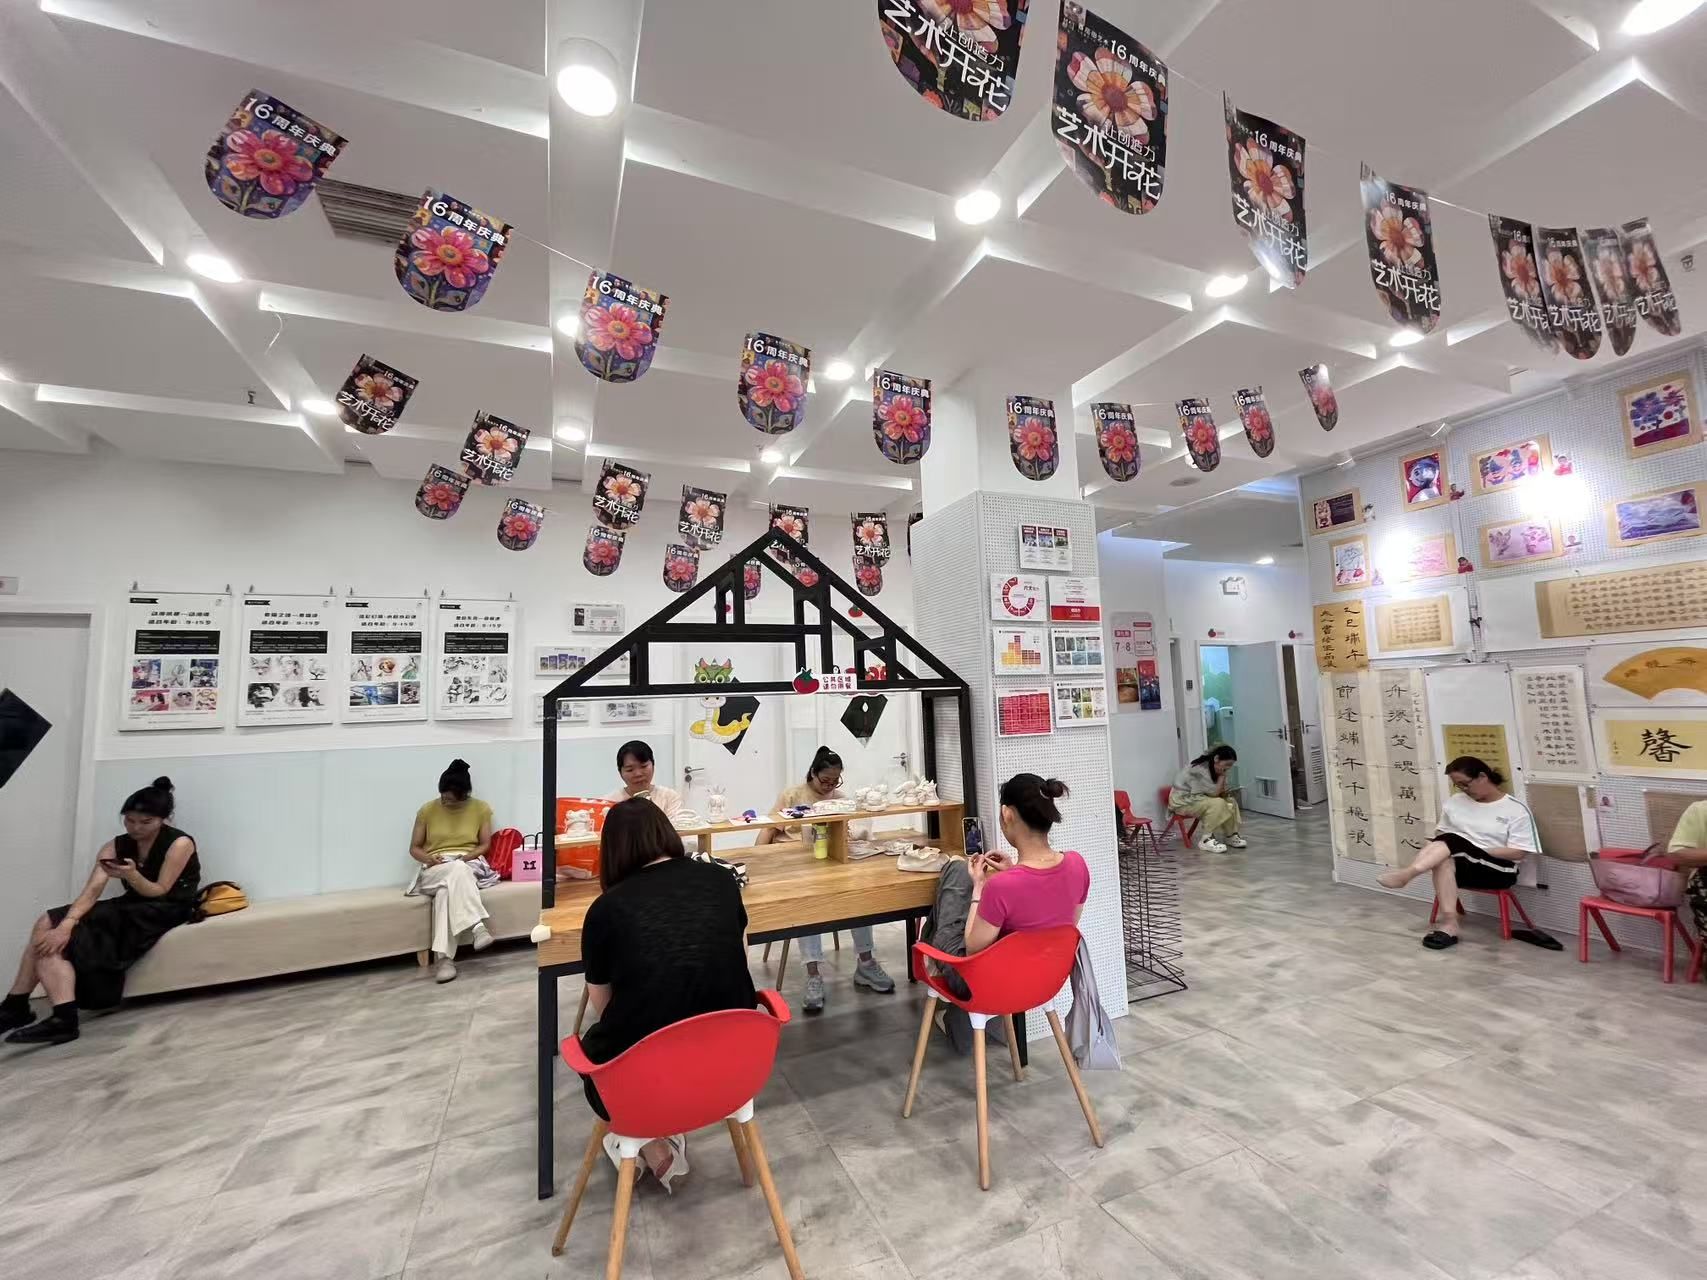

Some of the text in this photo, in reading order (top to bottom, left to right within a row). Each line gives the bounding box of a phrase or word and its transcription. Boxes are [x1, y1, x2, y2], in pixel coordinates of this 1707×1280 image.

[1111, 39, 1166, 86] 16周年庆典
[244, 97, 337, 157] 16周年庆典
[1056, 106, 1161, 201] 艺术开花
[424, 195, 506, 247] 16周年庆典
[1235, 193, 1307, 271] 艺术开花
[592, 276, 663, 317] 16周年庆典
[1372, 258, 1440, 311] 艺术开花
[747, 338, 809, 368] 16周年庆典
[875, 375, 929, 398] 16周年庆典
[1008, 402, 1054, 418] 16周年庆典
[1638, 728, 1693, 763] 馨
